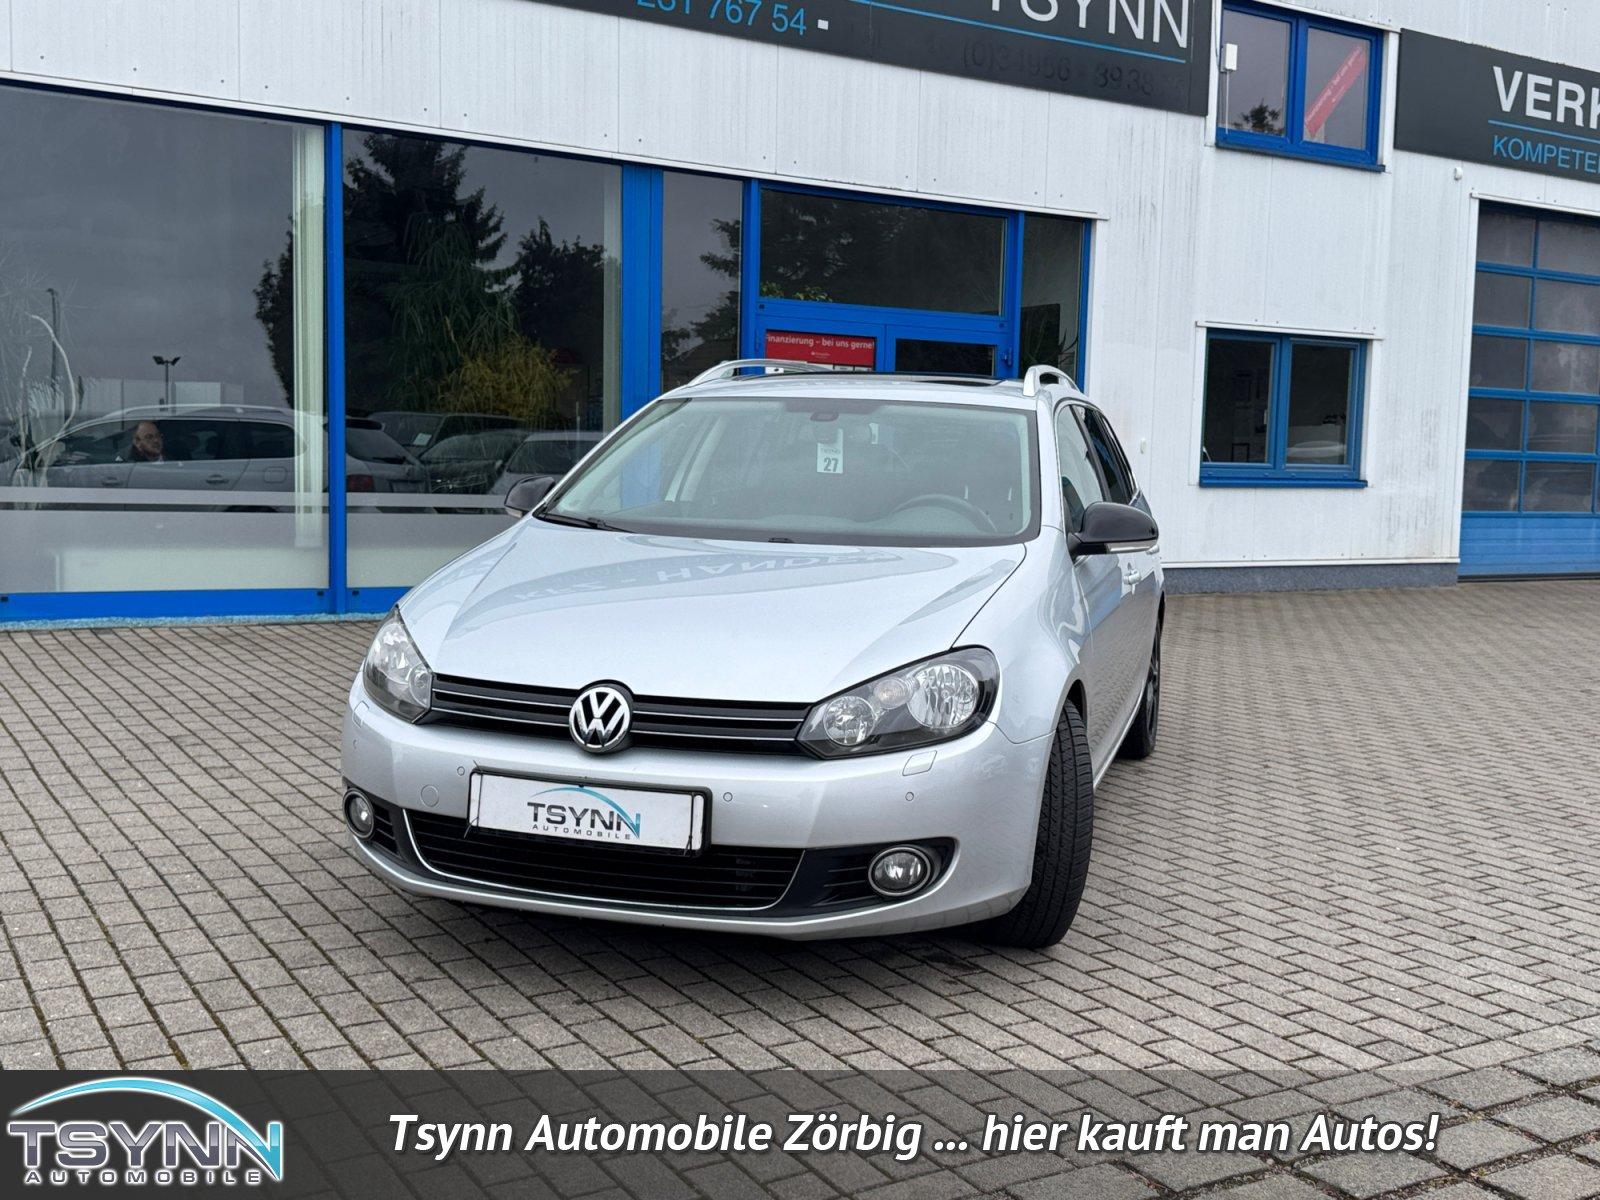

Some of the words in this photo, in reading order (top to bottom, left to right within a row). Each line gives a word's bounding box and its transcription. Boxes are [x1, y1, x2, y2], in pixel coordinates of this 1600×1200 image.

[771, 4, 807, 36] 54
[1493, 134, 1600, 174] KOMPETE
[822, 338, 834, 346] bei
[835, 340, 849, 348] uns
[823, 457, 838, 473] 27
[527, 802, 640, 839] TSYNN
[532, 823, 630, 840] AUTOMOBILE
